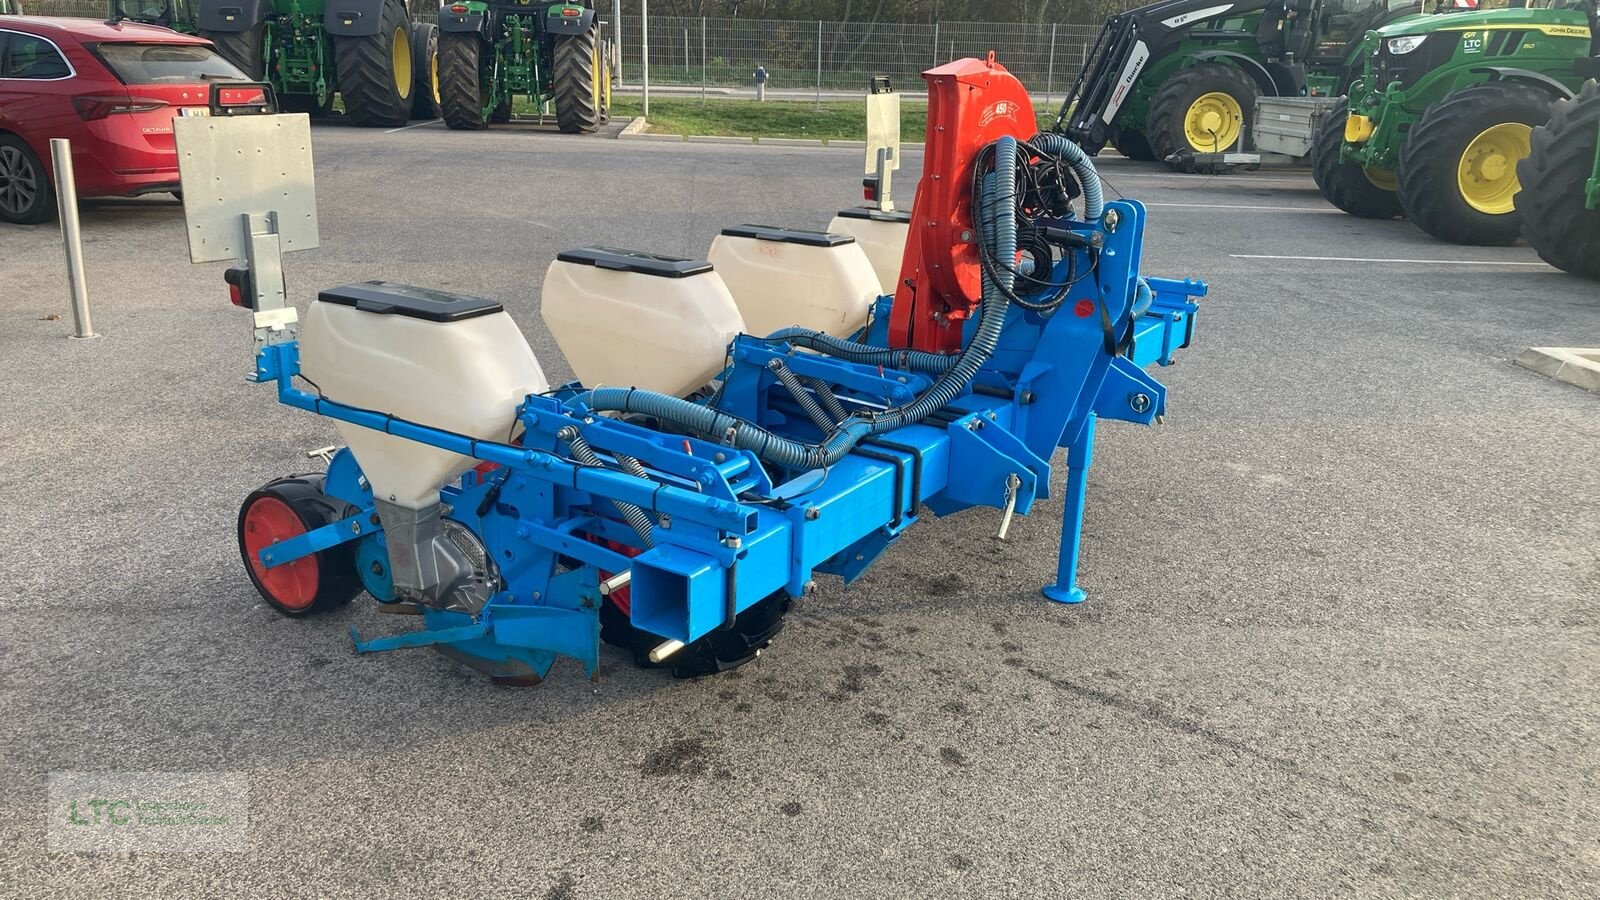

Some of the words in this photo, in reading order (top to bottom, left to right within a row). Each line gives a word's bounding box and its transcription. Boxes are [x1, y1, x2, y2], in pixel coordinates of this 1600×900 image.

[1566, 27, 1587, 35] DEERE
[1463, 39, 1481, 48] LTC
[995, 102, 1007, 115] 450
